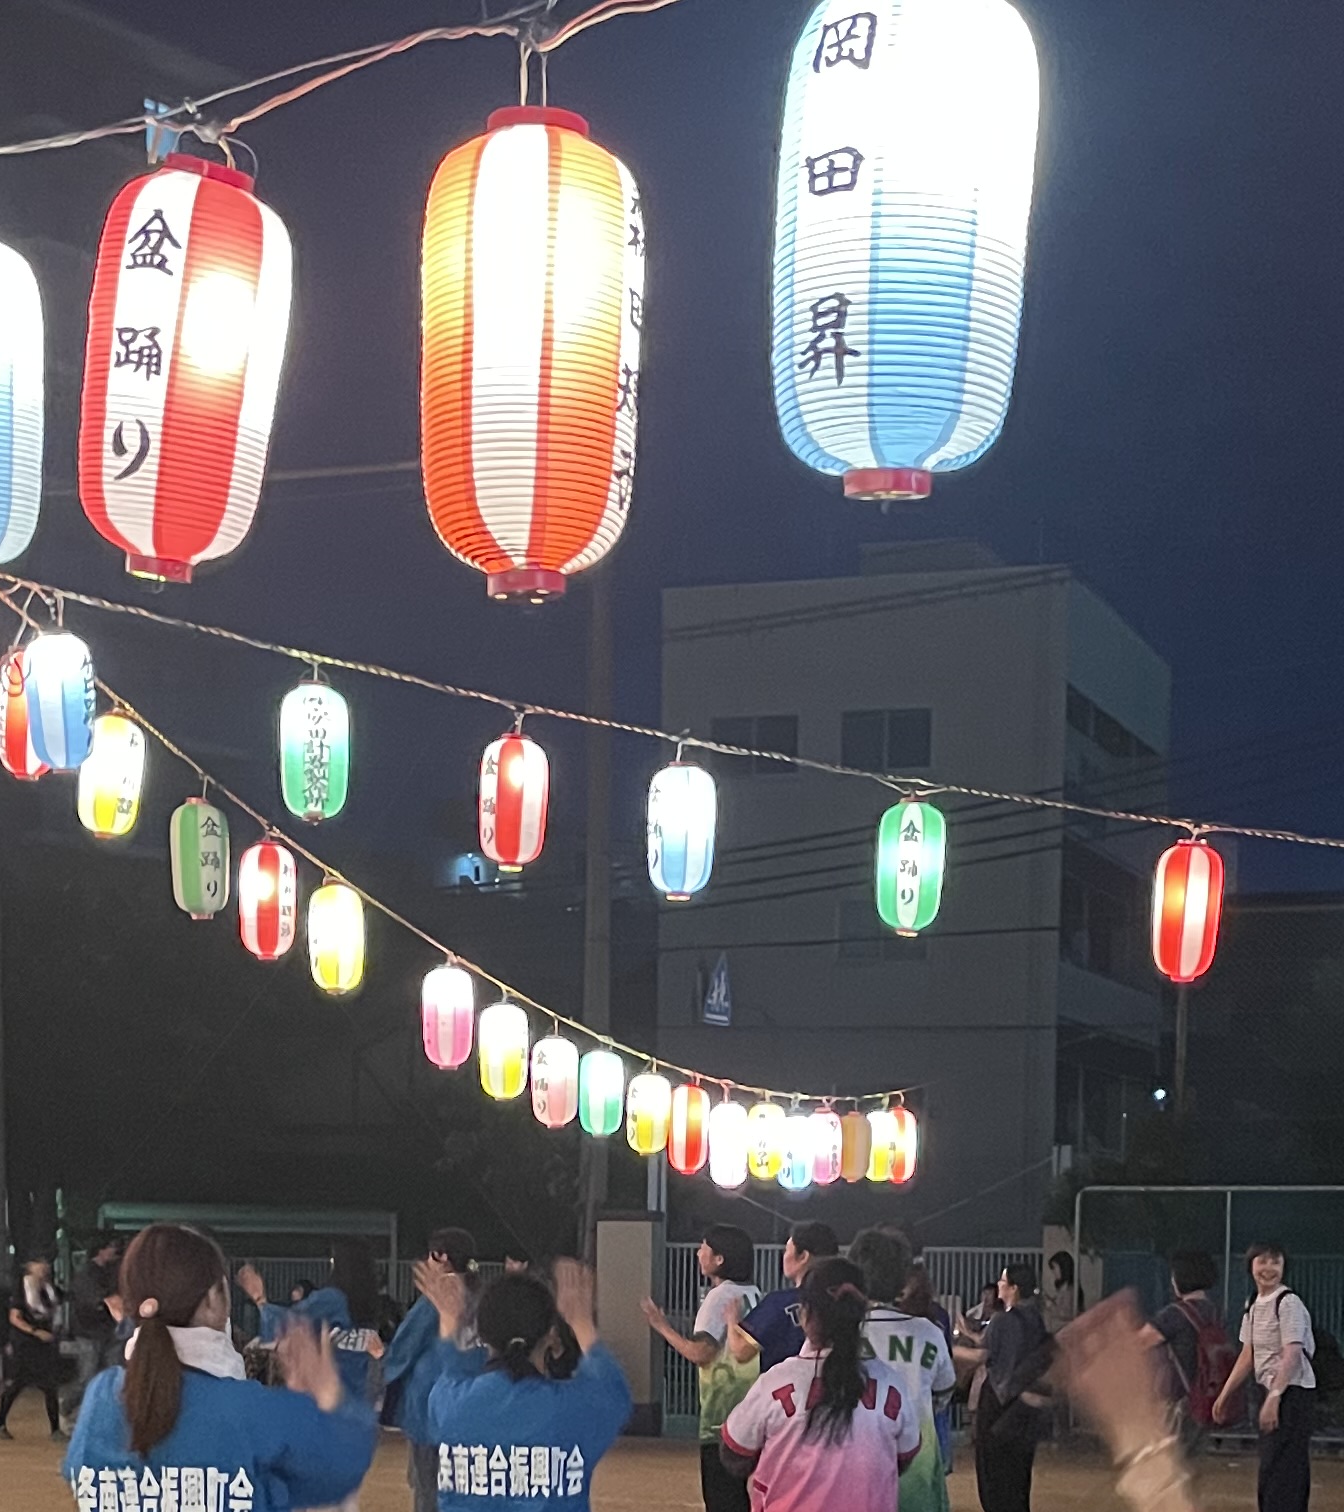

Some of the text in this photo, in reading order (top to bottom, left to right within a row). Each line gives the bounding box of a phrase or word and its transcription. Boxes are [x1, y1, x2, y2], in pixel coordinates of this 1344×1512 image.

[798, 11, 878, 387] 岡田昇
[112, 208, 184, 480] 盆踊り
[200, 815, 222, 898] 盆踊り
[901, 821, 922, 905] 盆踊り
